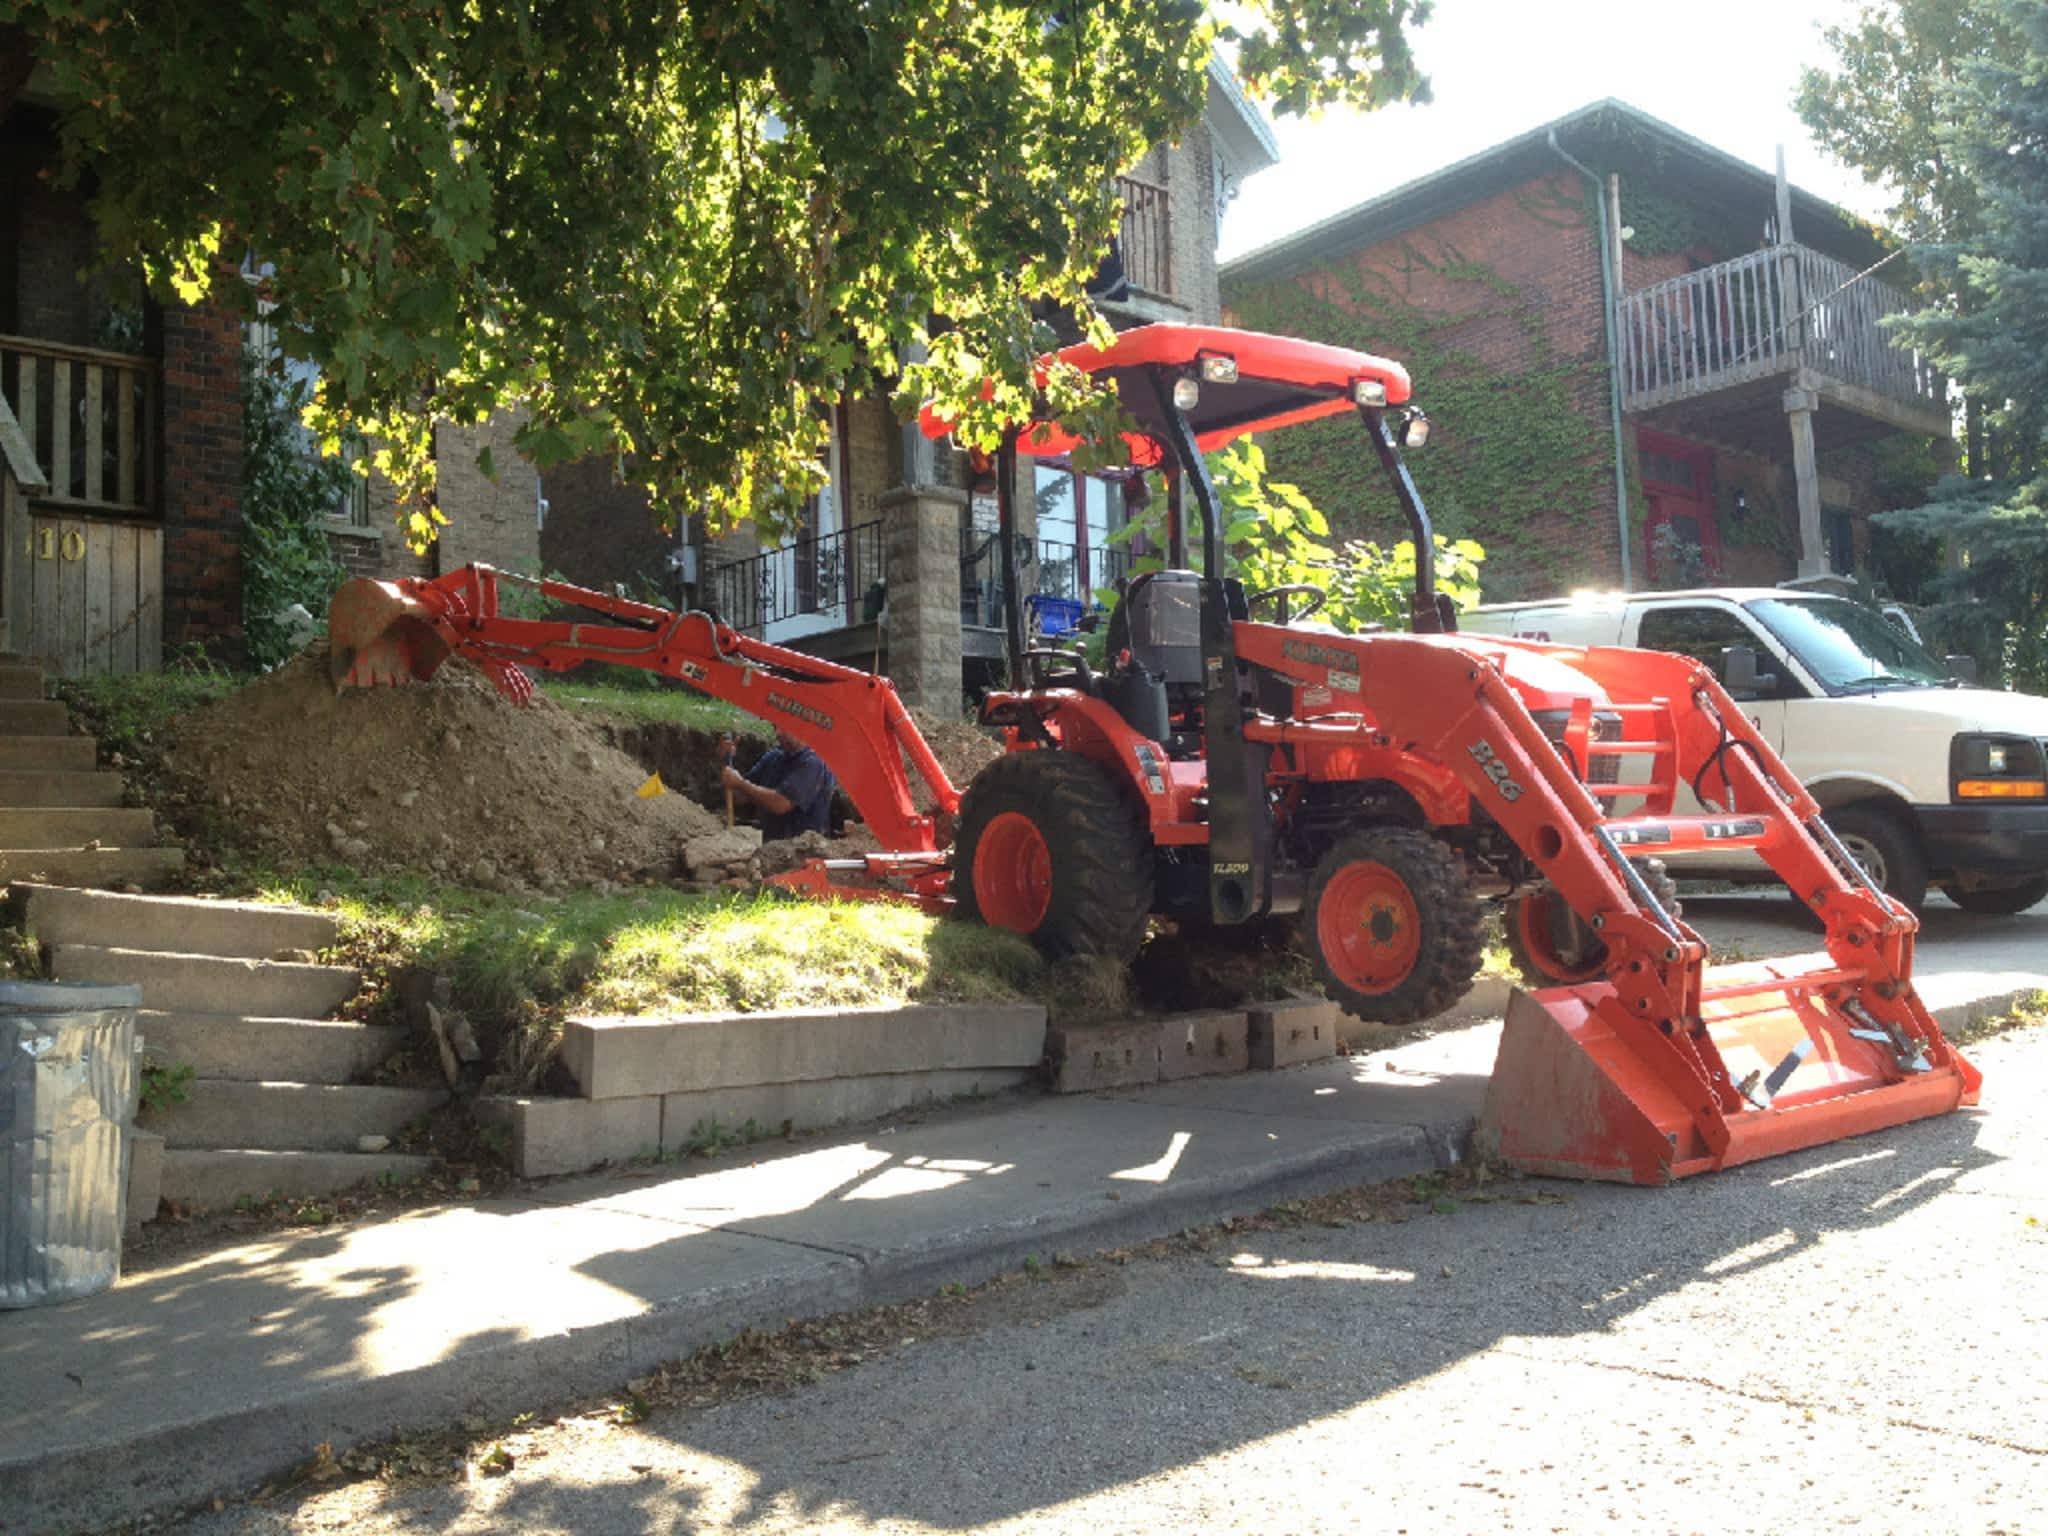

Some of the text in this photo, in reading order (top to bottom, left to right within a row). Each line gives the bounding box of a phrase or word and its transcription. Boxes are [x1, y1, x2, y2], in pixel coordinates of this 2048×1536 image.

[1282, 639, 1358, 673] KUBOTA
[768, 691, 833, 730] KUBOTA
[1466, 739, 1525, 801] B26
